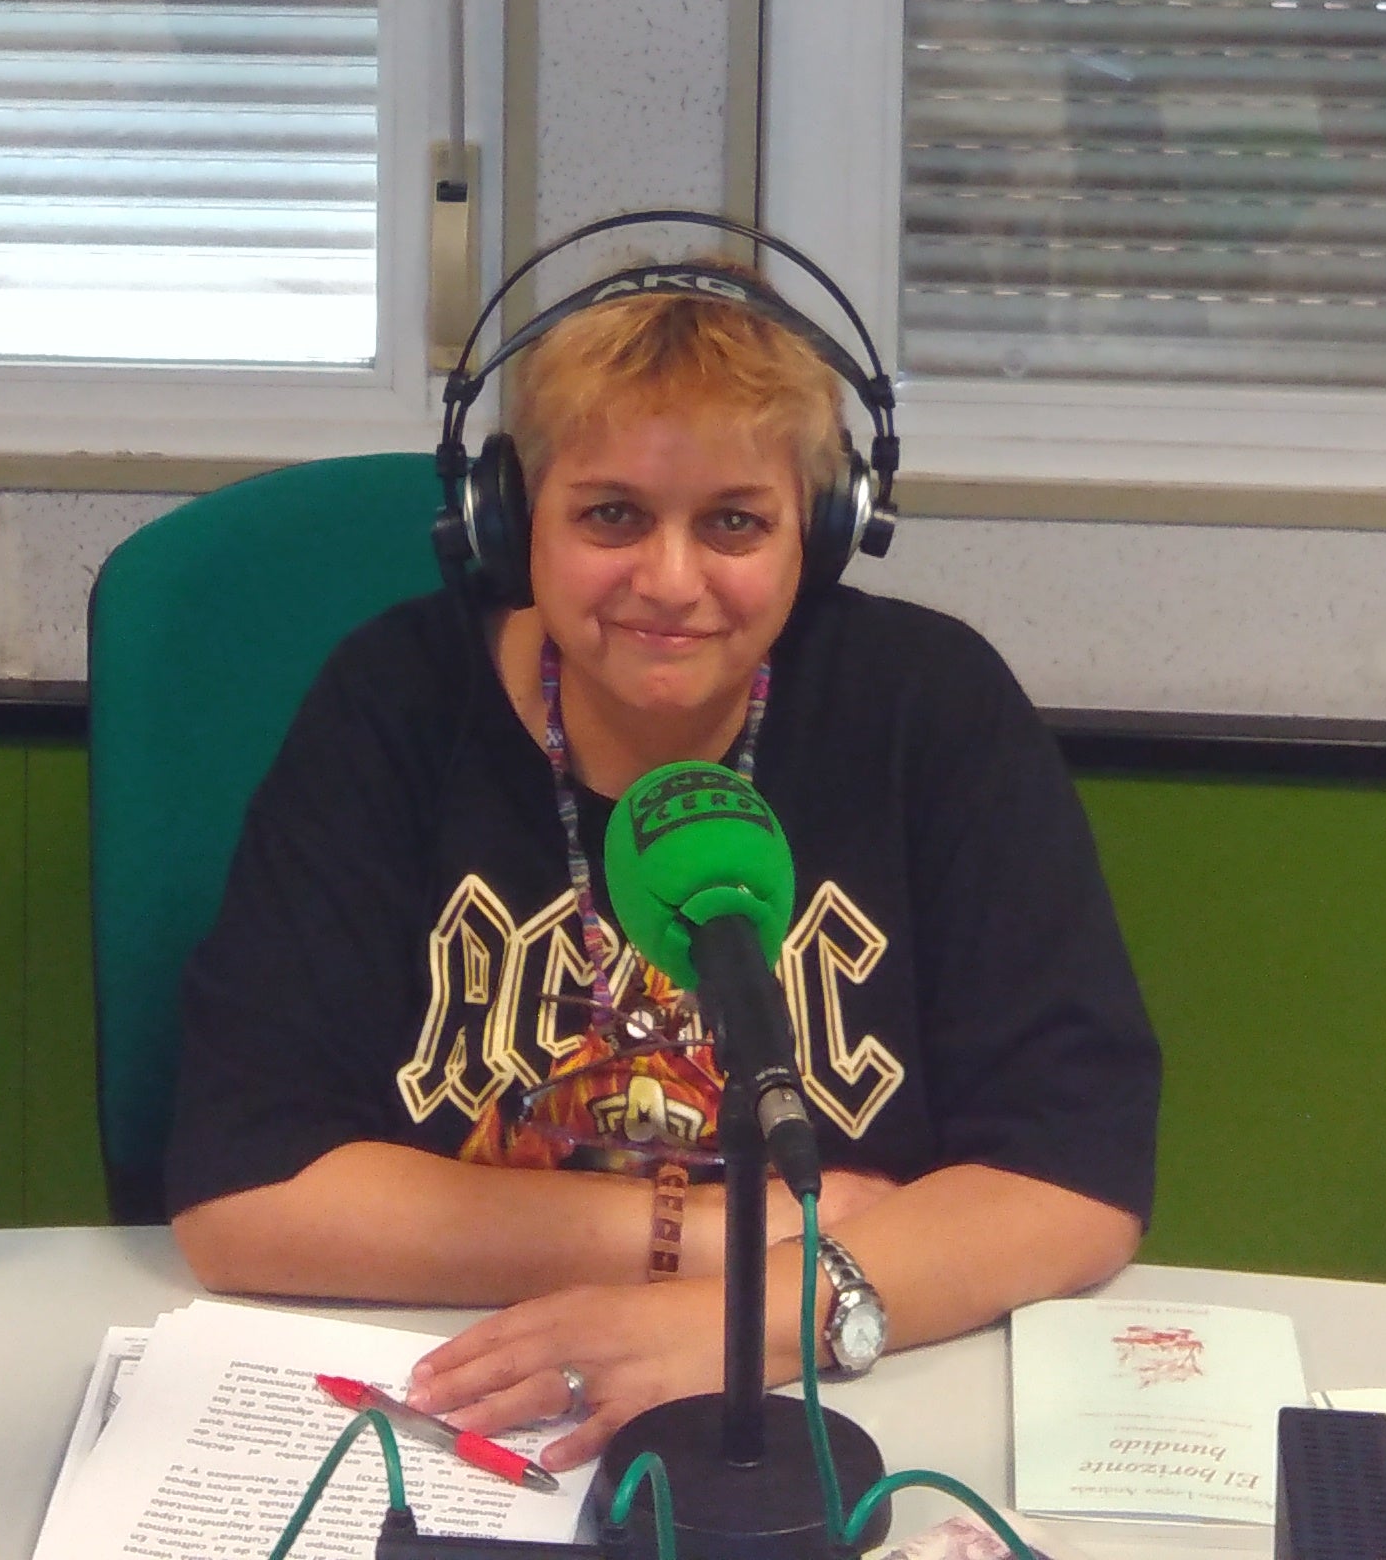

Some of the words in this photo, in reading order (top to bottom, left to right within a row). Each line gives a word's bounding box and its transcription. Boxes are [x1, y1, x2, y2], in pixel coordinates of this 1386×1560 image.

[591, 273, 748, 303] AKG
[1078, 1459, 1218, 1485] horizonte
[1224, 1470, 1262, 1491] El
